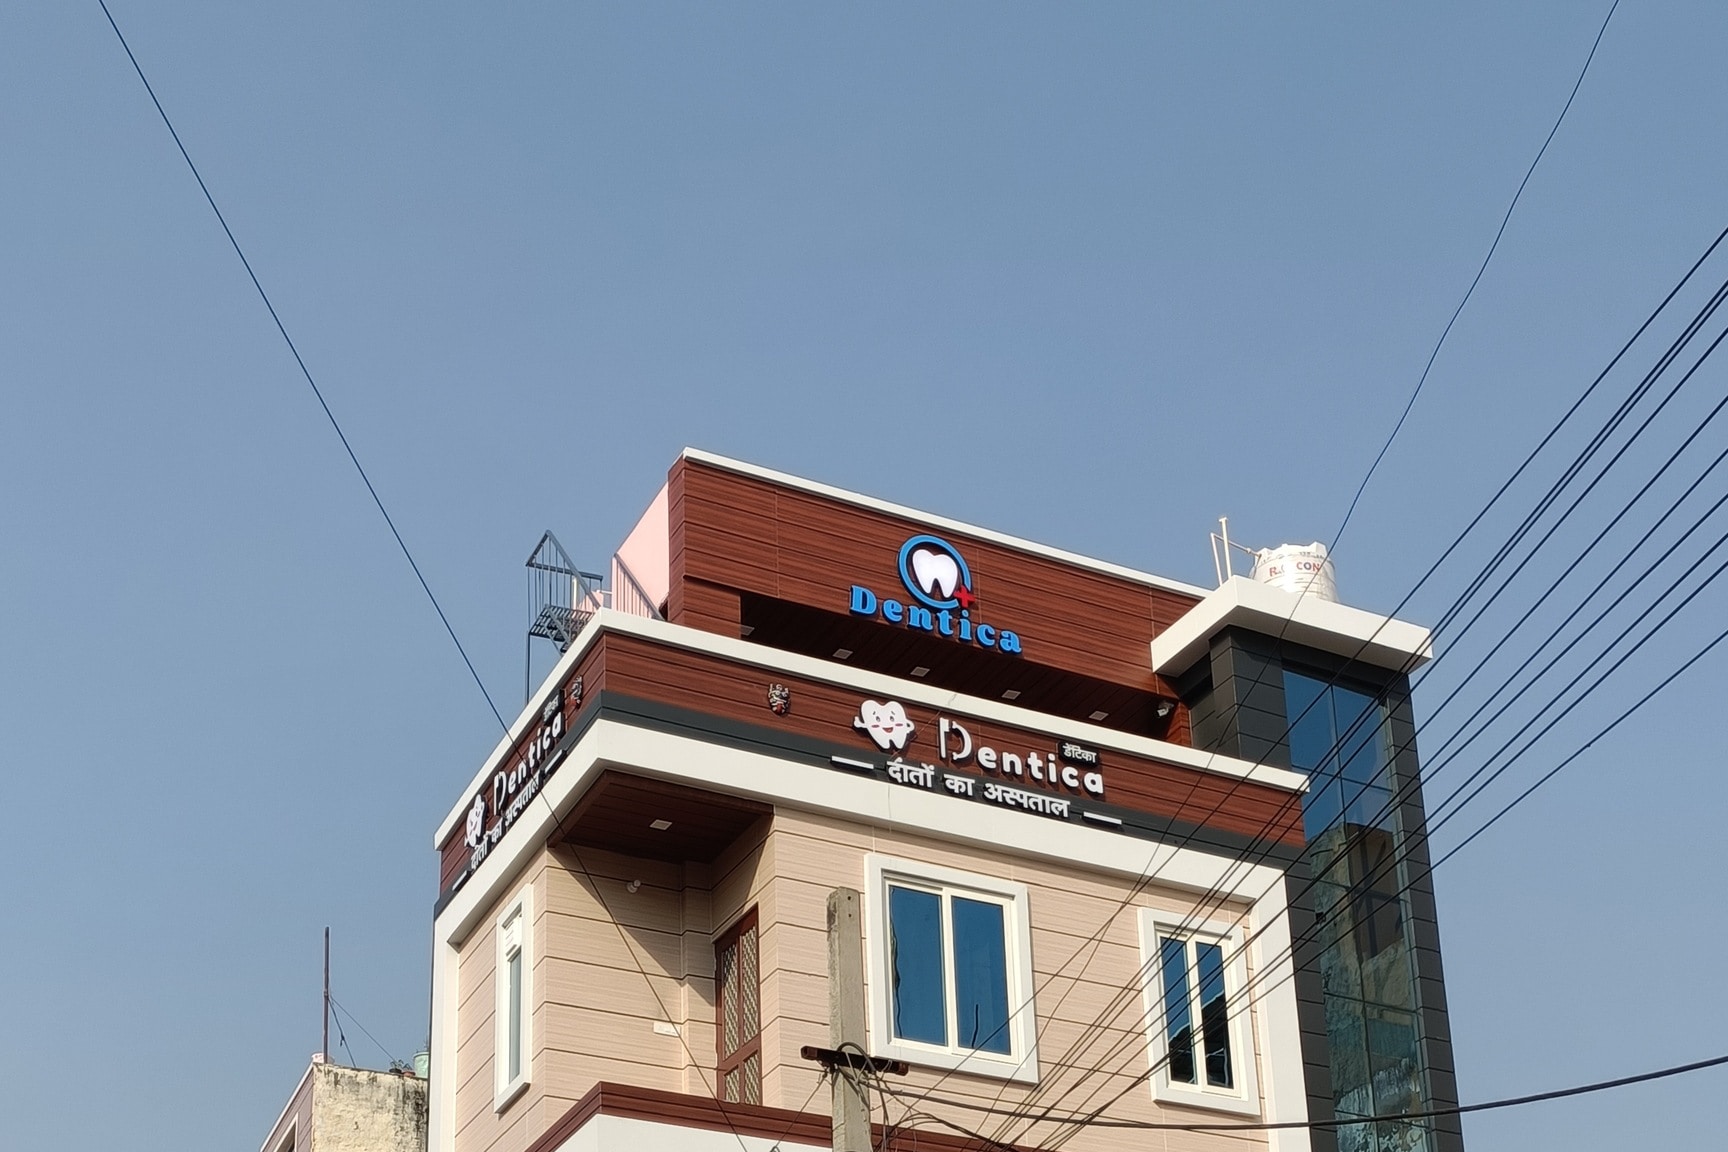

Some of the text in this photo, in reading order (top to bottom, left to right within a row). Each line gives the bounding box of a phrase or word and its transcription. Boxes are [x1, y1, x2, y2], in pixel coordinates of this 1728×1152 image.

[850, 585, 1022, 654] Dentica
[494, 711, 562, 816] Dentica
[939, 717, 1104, 794] Dentica
[944, 773, 975, 796] का
[984, 783, 1071, 818] अस्पताल
